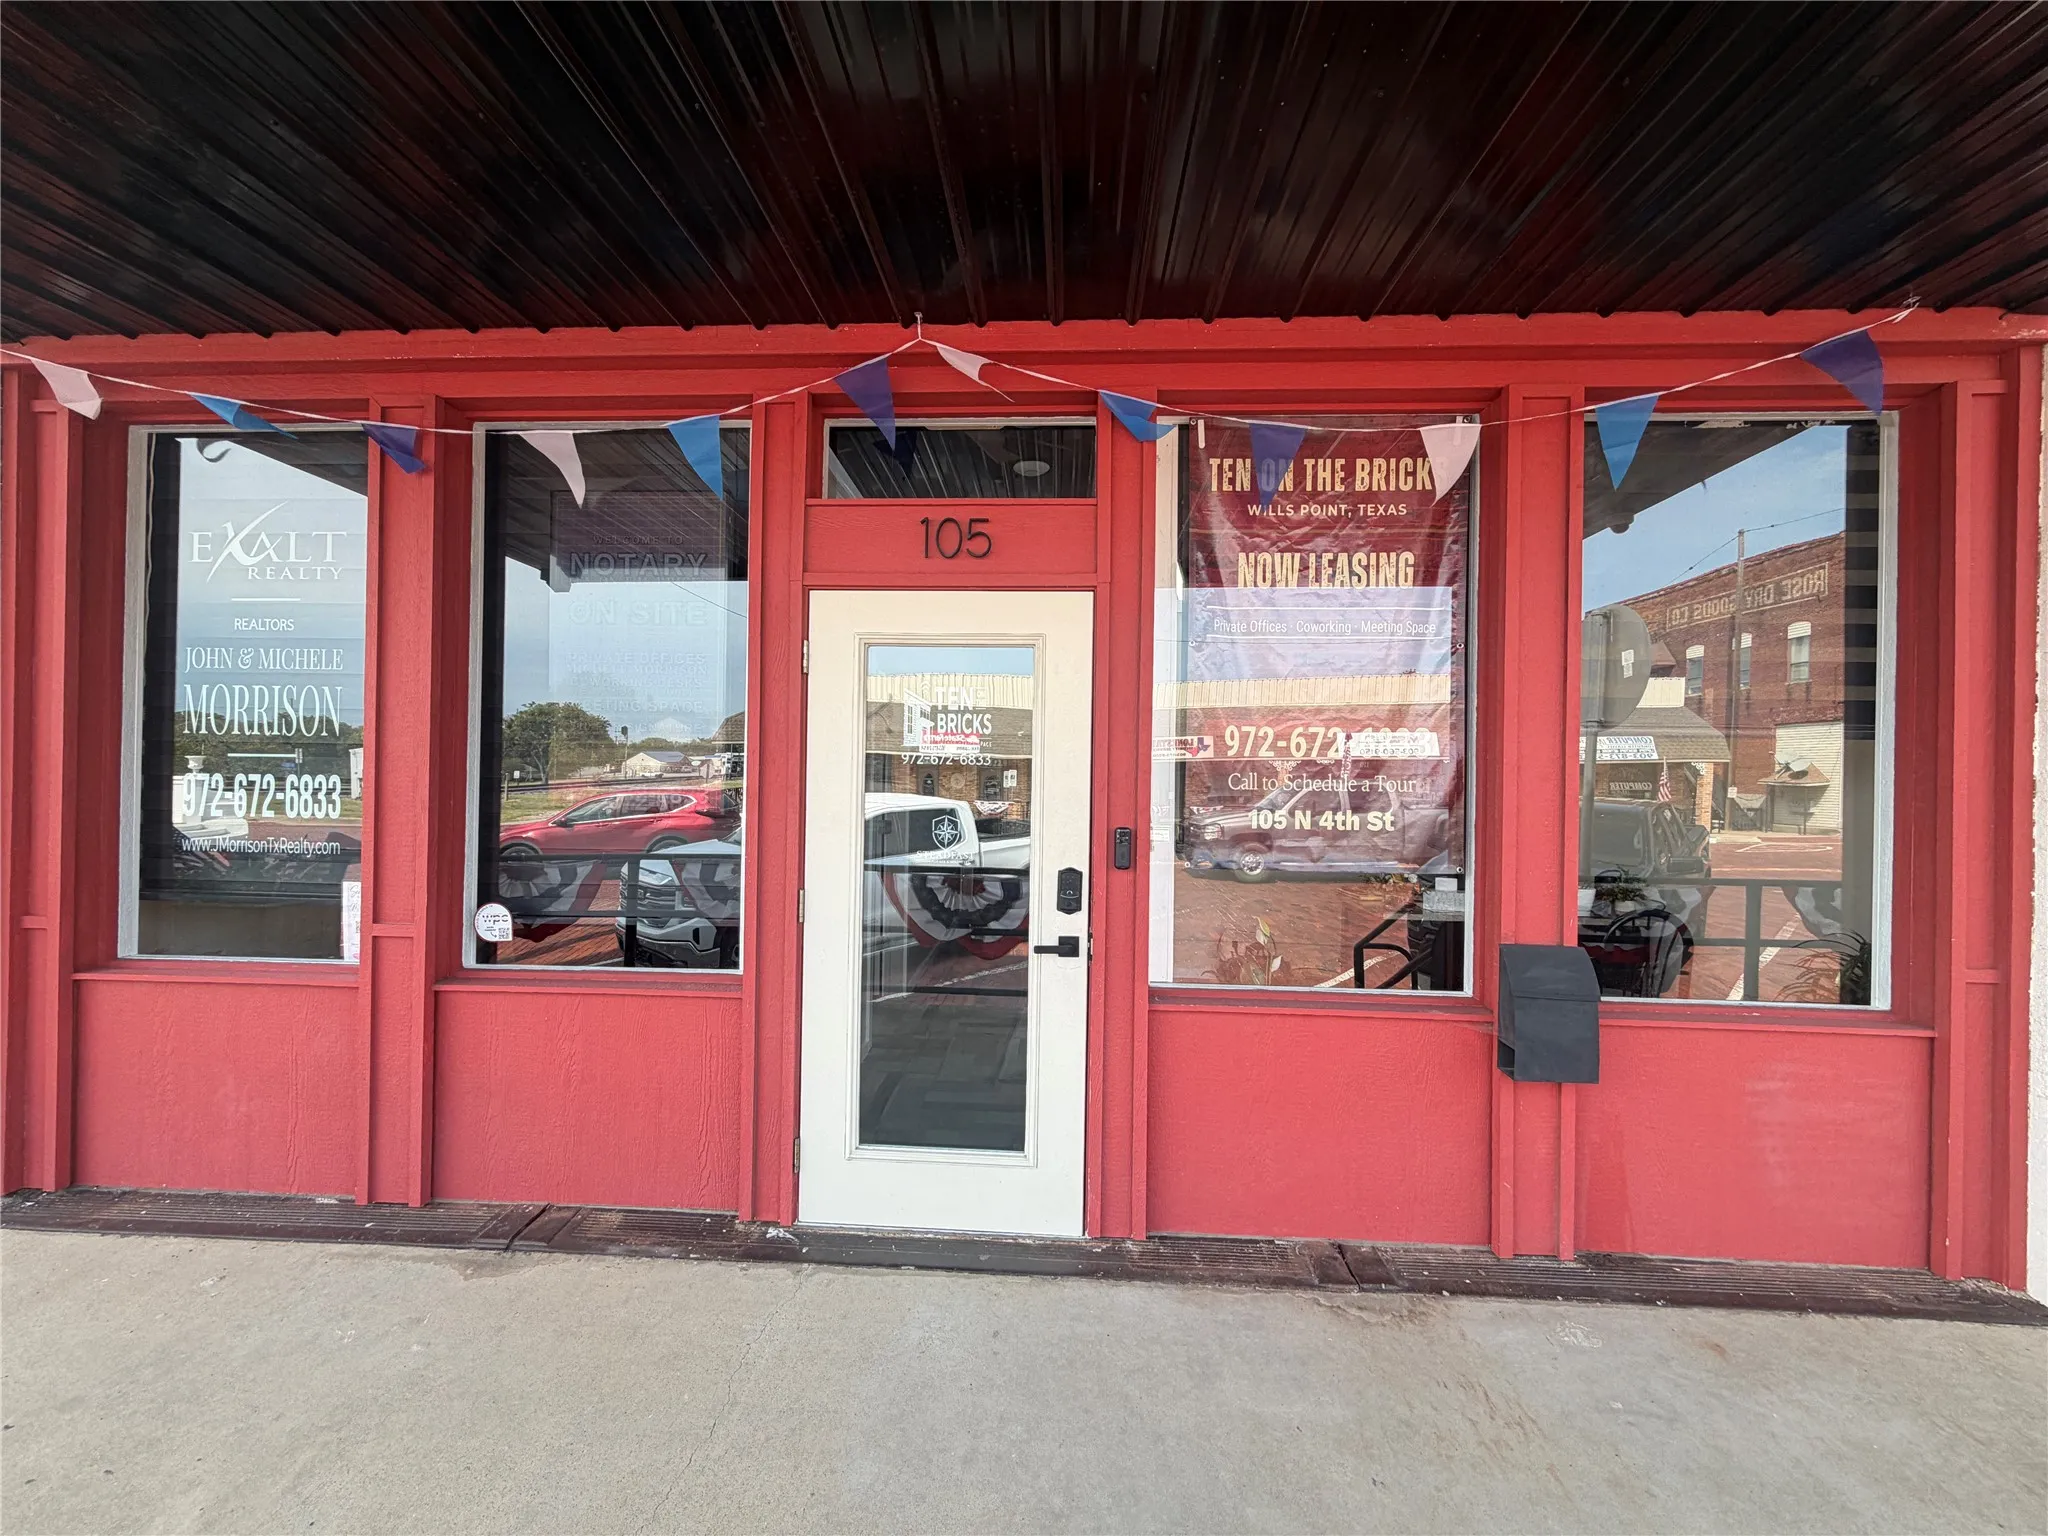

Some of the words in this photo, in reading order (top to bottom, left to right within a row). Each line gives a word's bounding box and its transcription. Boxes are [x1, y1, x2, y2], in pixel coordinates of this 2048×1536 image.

[1209, 457, 1251, 492] TEN
[1303, 457, 1346, 492] THE
[1355, 457, 1446, 492] BRICK
[1247, 504, 1294, 516] WILLS
[1300, 503, 1352, 518] POINT,
[1358, 503, 1408, 516] TEXAS
[187, 500, 348, 583] EXALT
[593, 535, 660, 545] WELCOME
[667, 535, 684, 545] TO
[920, 516, 992, 559] 105
[247, 566, 344, 580] REALTY
[569, 551, 708, 577] NOTARY
[1237, 552, 1300, 589] NOW
[1308, 551, 1416, 589] LEASING
[233, 618, 295, 631] REALTORS
[629, 599, 709, 626] SITE
[1213, 619, 1247, 633] Private
[1250, 619, 1287, 634] Offices
[1296, 620, 1352, 635] Coworking
[1361, 620, 1403, 635] Meeting
[1405, 620, 1437, 635] Space
[184, 647, 234, 674] JOHN
[238, 647, 254, 670] &
[258, 648, 344, 671] MICHELE
[182, 683, 343, 737] MORRISON
[935, 686, 974, 711] TEN
[937, 713, 992, 735] BRICKS
[1224, 725, 1430, 758] 972-672
[901, 753, 991, 766] 972-672-6833
[1228, 772, 1258, 791] Call
[1261, 774, 1278, 791] to
[1282, 772, 1358, 792] Schedule
[1361, 780, 1370, 792] a
[1376, 776, 1417, 793] Tour
[182, 772, 342, 819] 972-672-6833
[1250, 810, 1288, 830] 105
[1294, 811, 1312, 830] N
[1319, 810, 1360, 831] 4th
[1366, 810, 1395, 831] St
[181, 835, 341, 858] www.JMorrisonTxRealty.com
